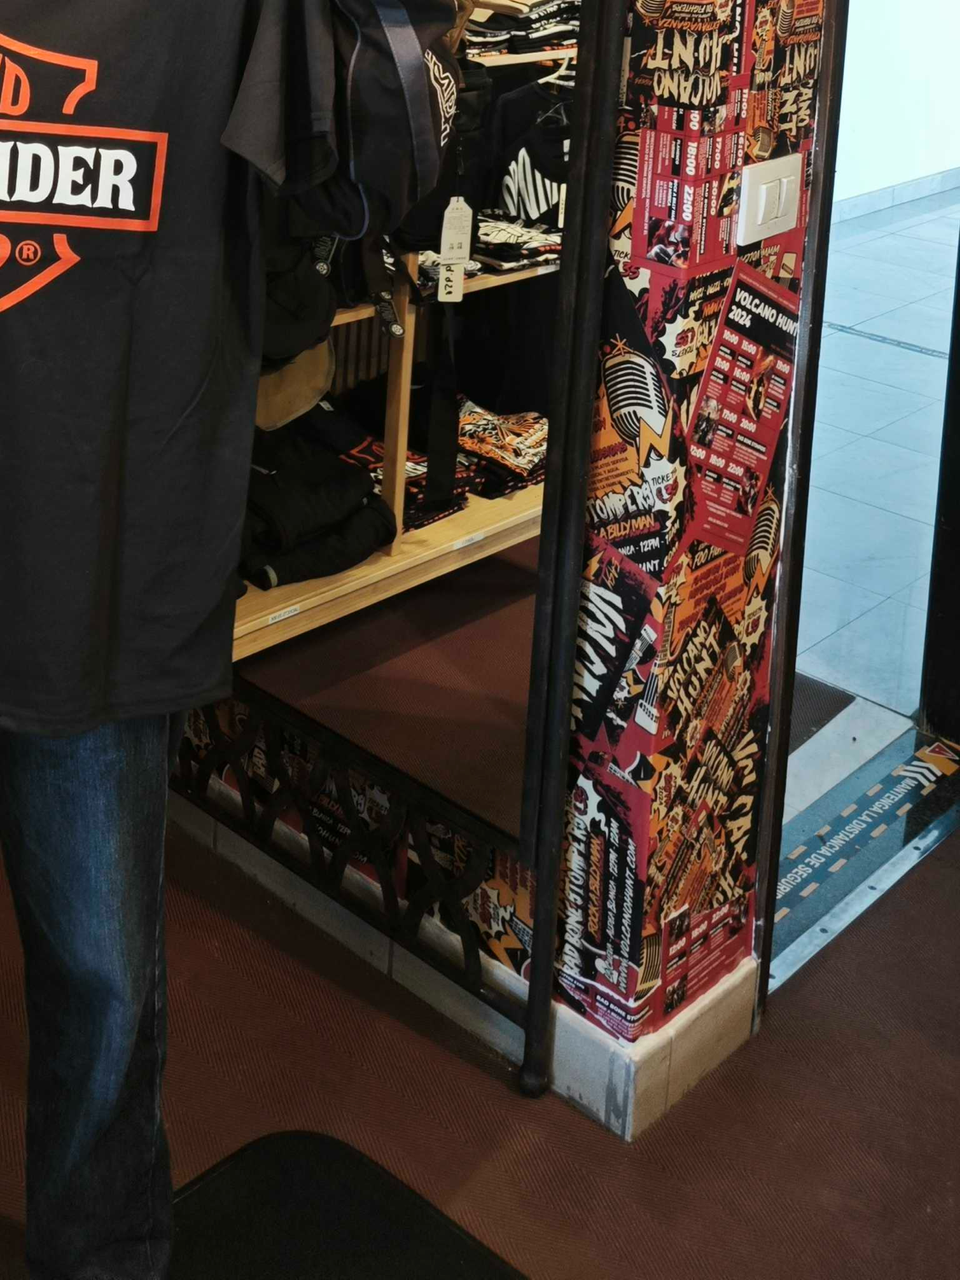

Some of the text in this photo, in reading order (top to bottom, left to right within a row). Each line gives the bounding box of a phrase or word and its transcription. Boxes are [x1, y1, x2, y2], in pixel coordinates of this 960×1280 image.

[653, 70, 722, 106] VOLCANO
[740, 88, 749, 119] 11:00
[686, 141, 698, 176] 18:00
[714, 137, 723, 169] 17:00
[736, 131, 746, 167] 16:00
[682, 184, 694, 221] 22:00
[710, 180, 719, 216] 20:00
[728, 306, 753, 329] 2024
[734, 287, 800, 337] VOLCANO HUNT
[728, 463, 745, 476] 22:00
[607, 514, 656, 540] BILLY MAN
[640, 537, 661, 554] 12PM
[873, 778, 919, 816] MANTENGA
[817, 820, 864, 860] DISTANCIA
[606, 817, 620, 939] ALDEA BLANCA 12PM 12AM
[565, 903, 585, 950] BONE
[618, 838, 638, 994] WWW.VOLCANOHUNT.COM
[596, 995, 626, 1016] BAD BONE
